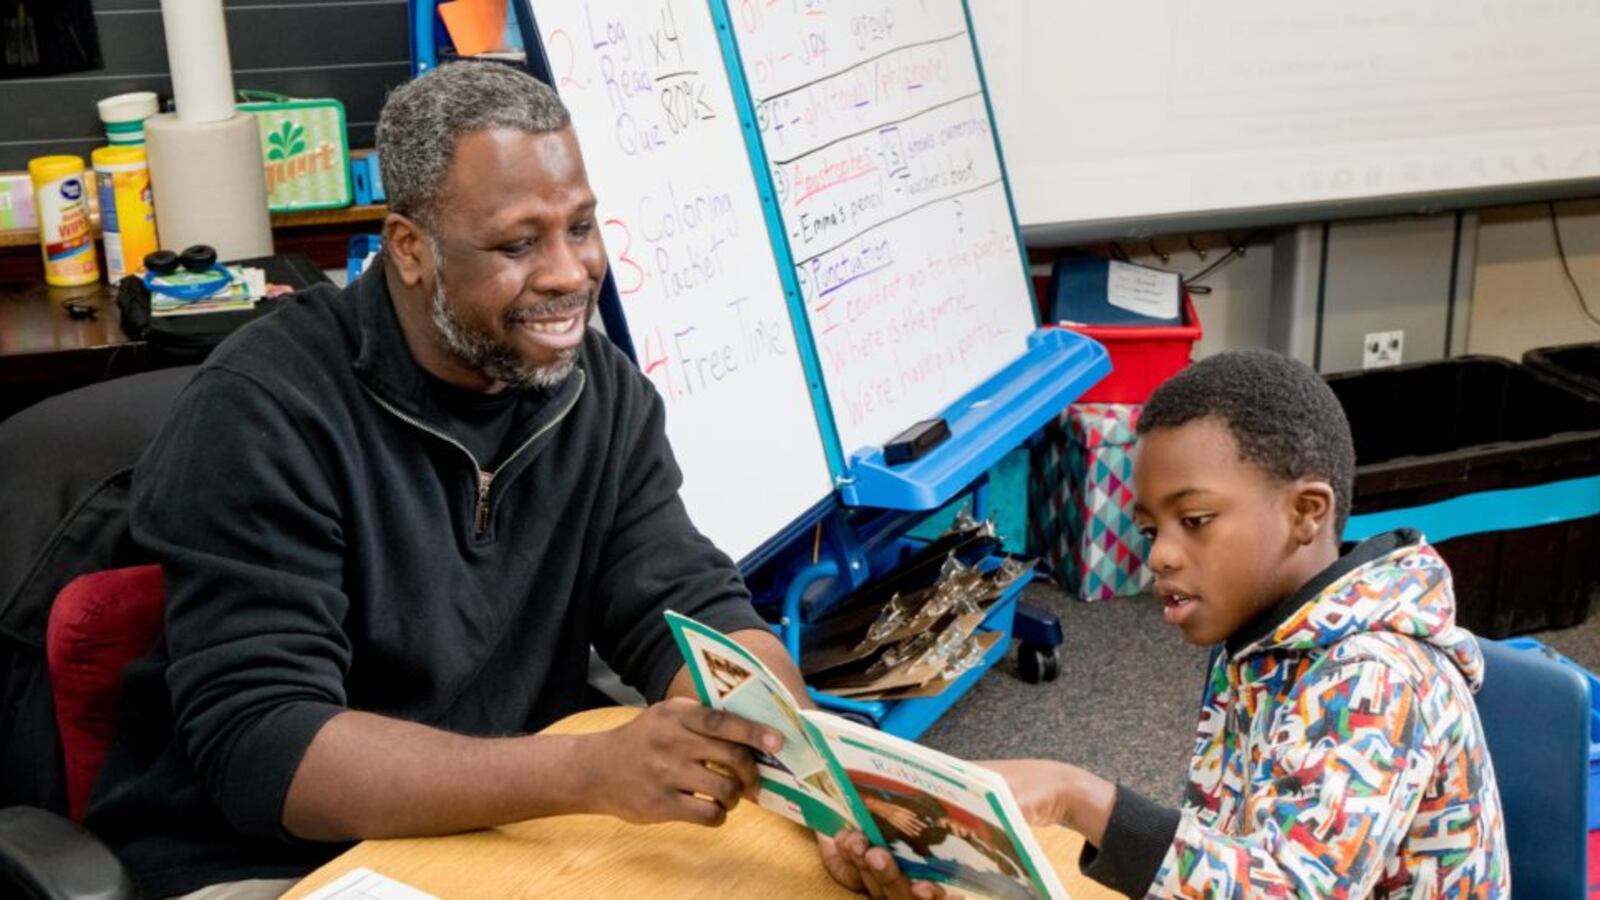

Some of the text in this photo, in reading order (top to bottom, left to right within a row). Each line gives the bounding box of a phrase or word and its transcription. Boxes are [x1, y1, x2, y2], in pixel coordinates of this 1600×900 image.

[584, 2, 633, 61] Log
[638, 183, 739, 243] Coloring
[604, 219, 725, 299] 3. Packet
[643, 296, 787, 404] 4. Free Time
